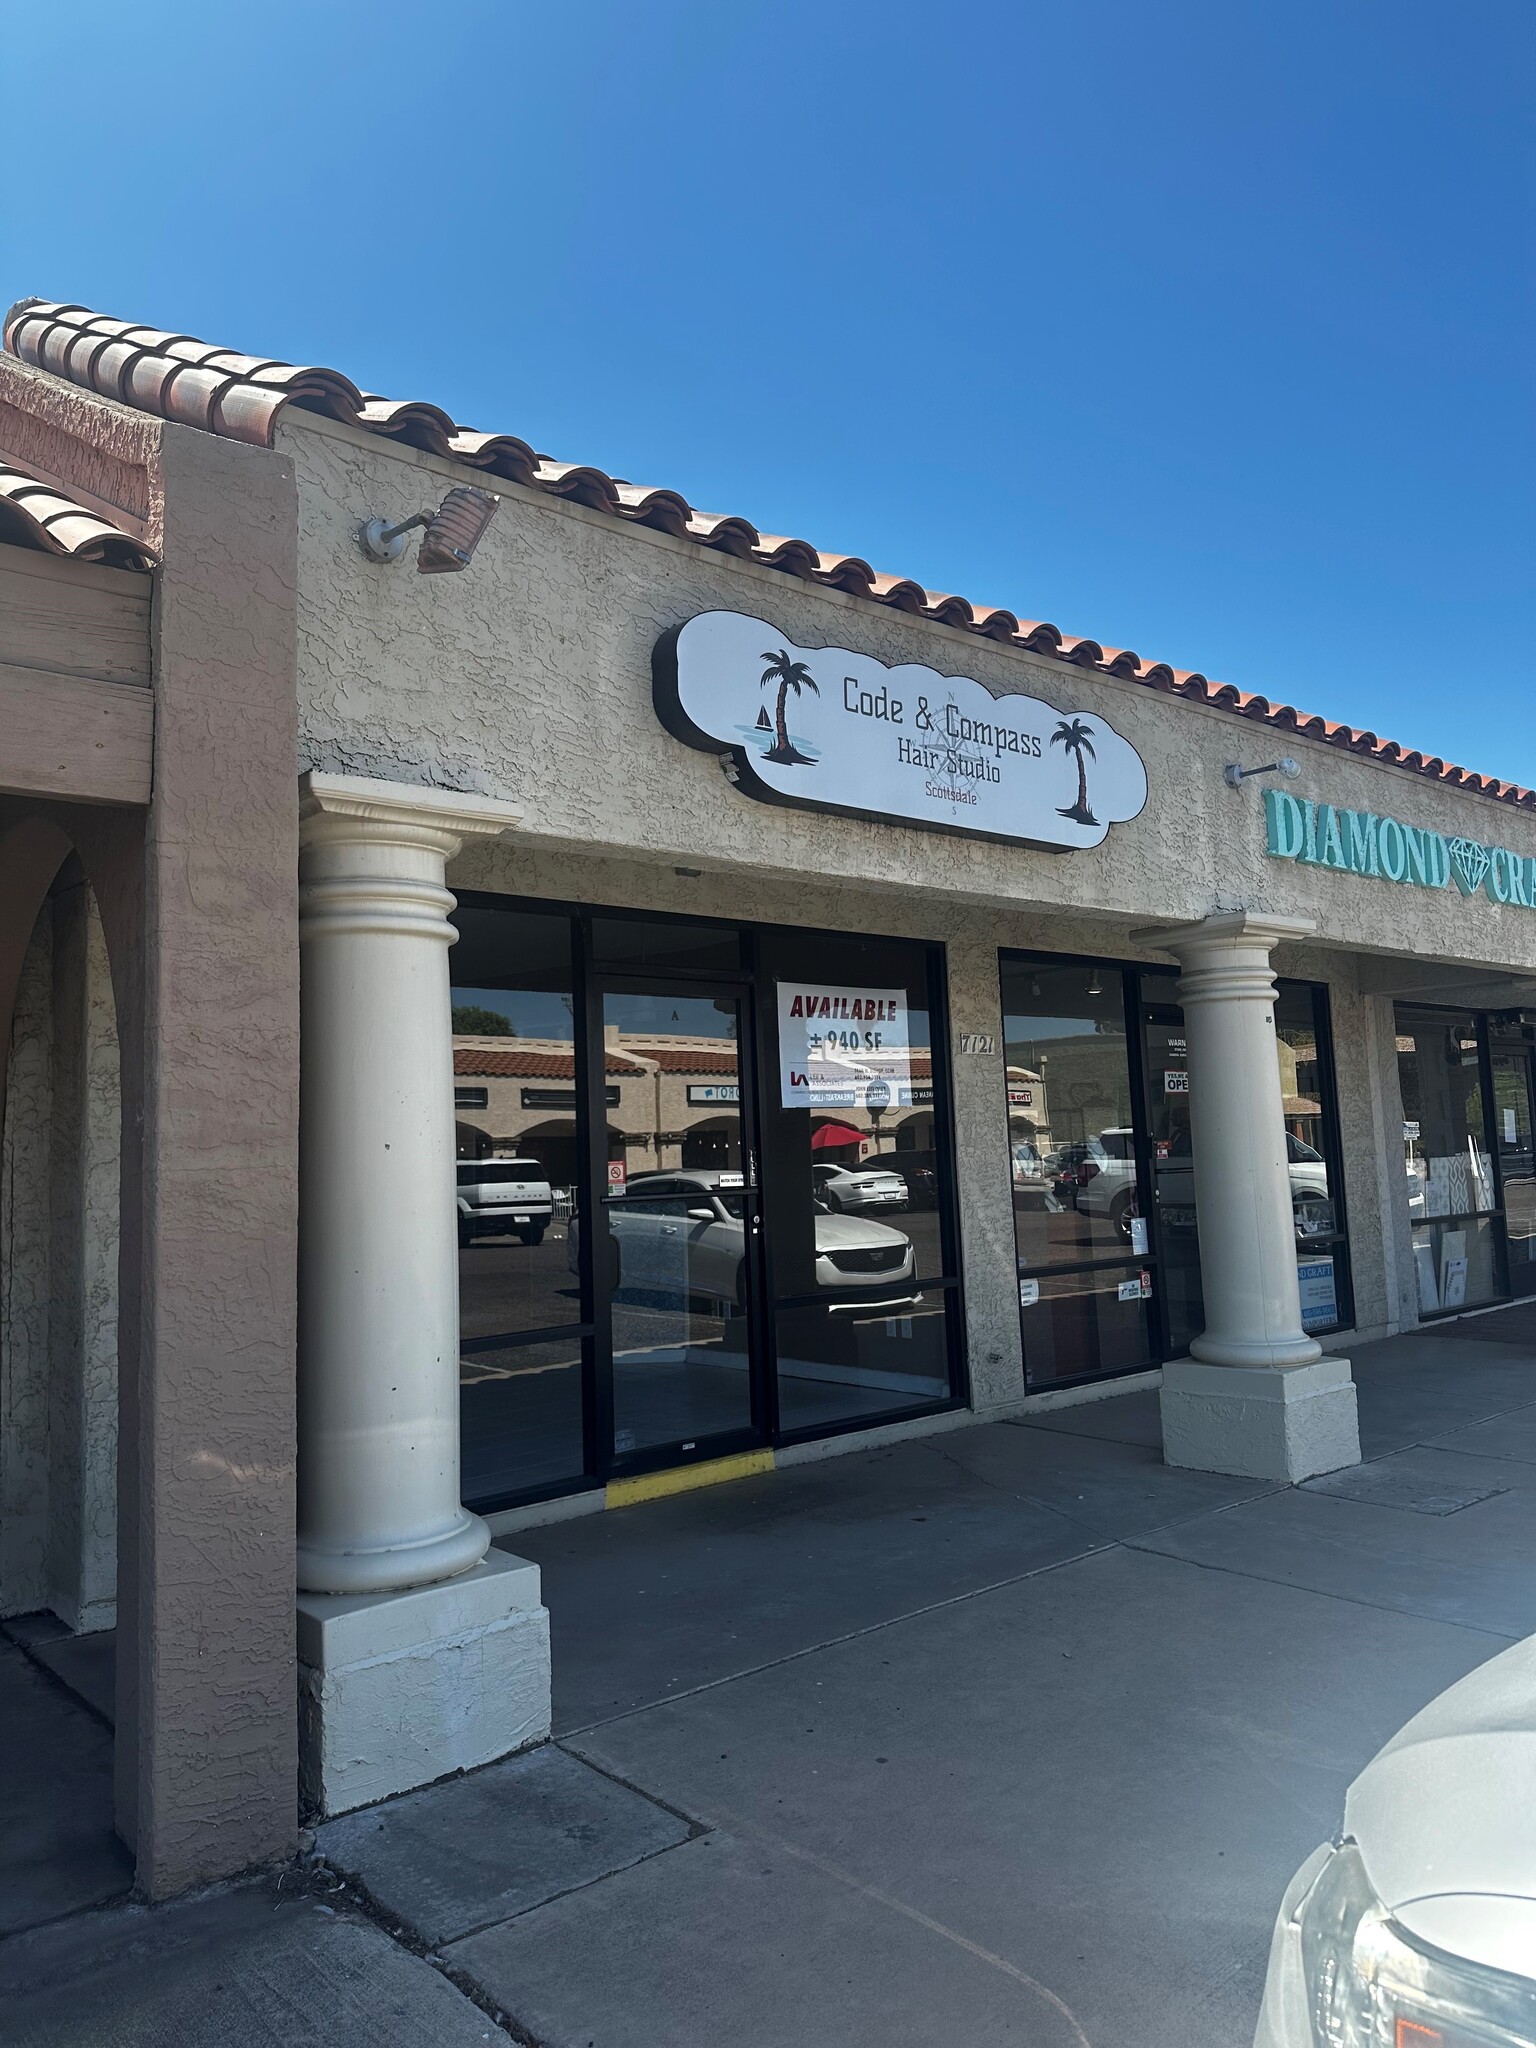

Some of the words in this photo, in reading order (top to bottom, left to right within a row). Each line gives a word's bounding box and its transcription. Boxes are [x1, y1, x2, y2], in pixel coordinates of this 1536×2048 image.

[843, 676, 904, 724] Code
[915, 695, 935, 732] &
[946, 703, 1042, 759] Compass
[897, 737, 939, 770] Hair
[946, 748, 1000, 784] Studio
[925, 781, 978, 806] Scottsdale
[1262, 789, 1451, 889] DIAMOND
[789, 995, 897, 1021] AVAILABLE
[827, 1030, 859, 1051] 940
[864, 1031, 882, 1051] SF
[962, 1034, 994, 1053] 7121
